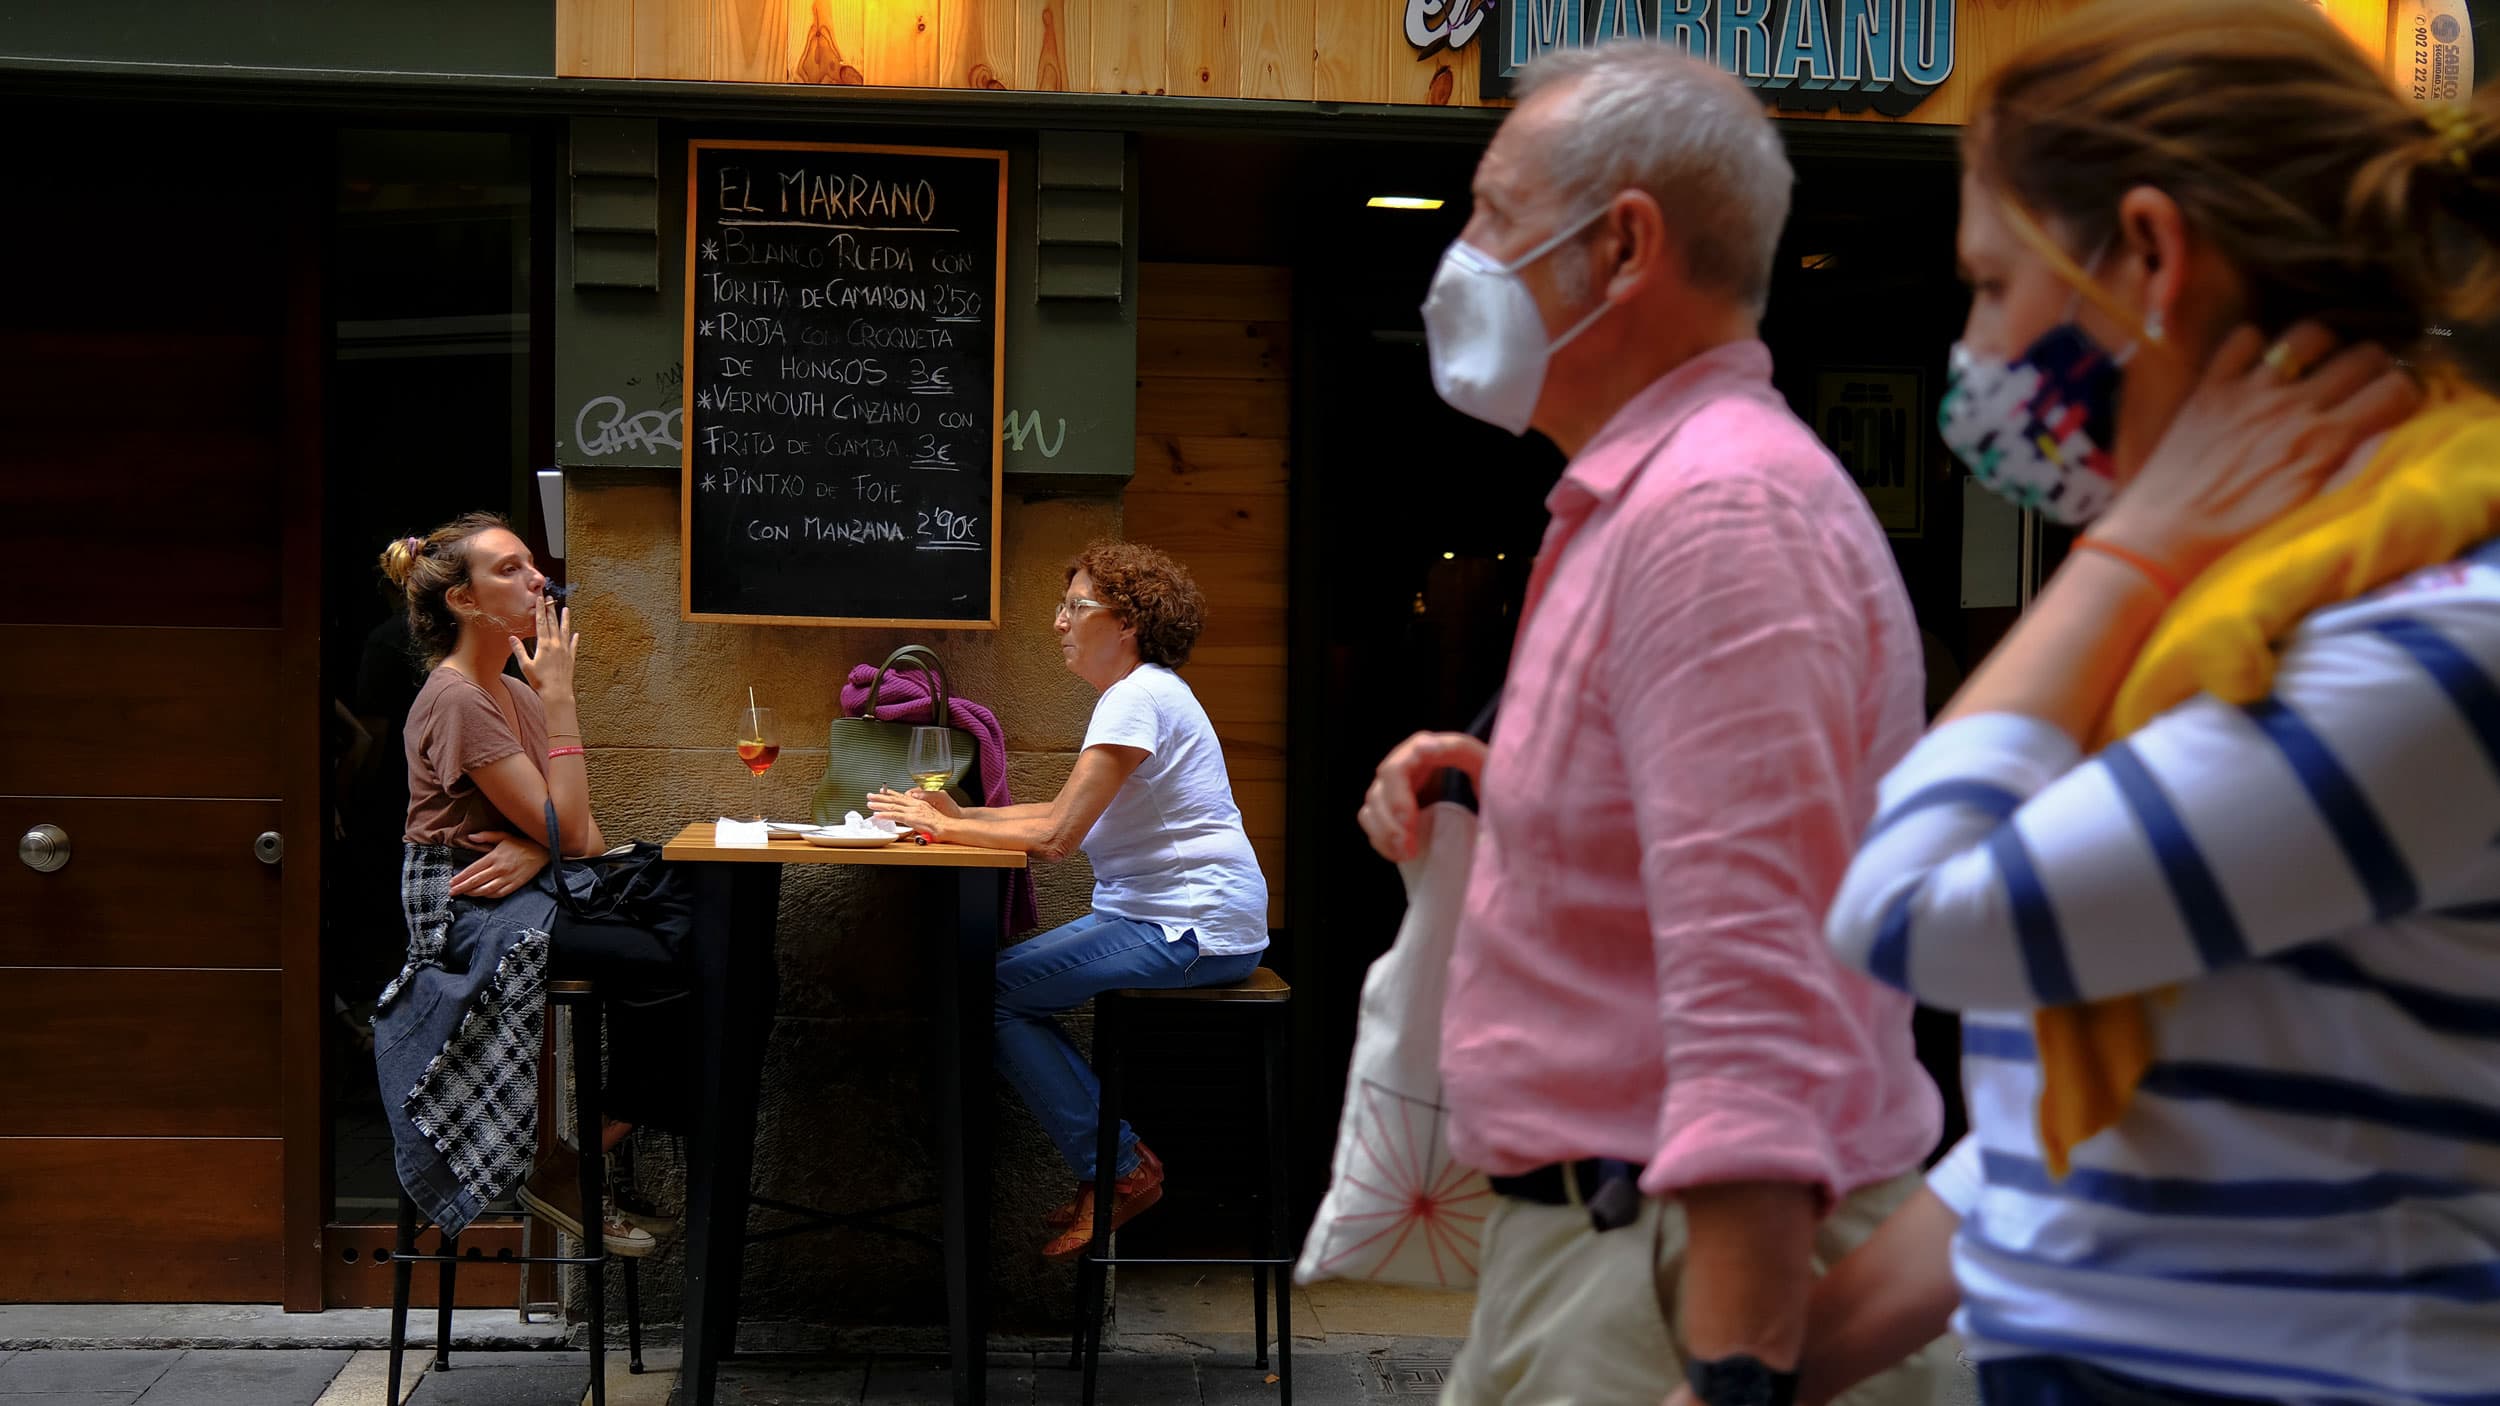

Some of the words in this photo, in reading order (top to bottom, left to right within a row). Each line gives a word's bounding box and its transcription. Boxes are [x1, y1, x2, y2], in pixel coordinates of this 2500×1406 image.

[2415, 27, 2428, 48] 902
[2414, 68, 2427, 82] 22
[2415, 51, 2428, 65] 22
[2444, 44, 2460, 100] SABICO
[2413, 85, 2426, 100] 24
[720, 167, 764, 213] EL
[778, 168, 936, 224] MARRANO
[723, 227, 824, 268] BLANCO
[931, 249, 973, 274] CON
[801, 288, 825, 310] DE
[826, 278, 926, 312] CAMARON
[716, 312, 787, 346] RIOJA
[847, 318, 953, 350] CROQUETA
[720, 356, 753, 378] DE
[780, 355, 888, 386] HONGOS
[910, 358, 951, 385] 3€
[713, 384, 825, 419] VERMOUTH
[832, 394, 922, 425] CINZANO
[938, 411, 974, 428] CON
[701, 425, 776, 456] FRITO
[787, 439, 813, 455] DE
[825, 433, 900, 457] GAMBA
[916, 433, 951, 461] 3€
[722, 466, 806, 498] PINTXO
[815, 482, 838, 498] DE
[851, 474, 904, 504] FOIE
[748, 519, 790, 541] CON
